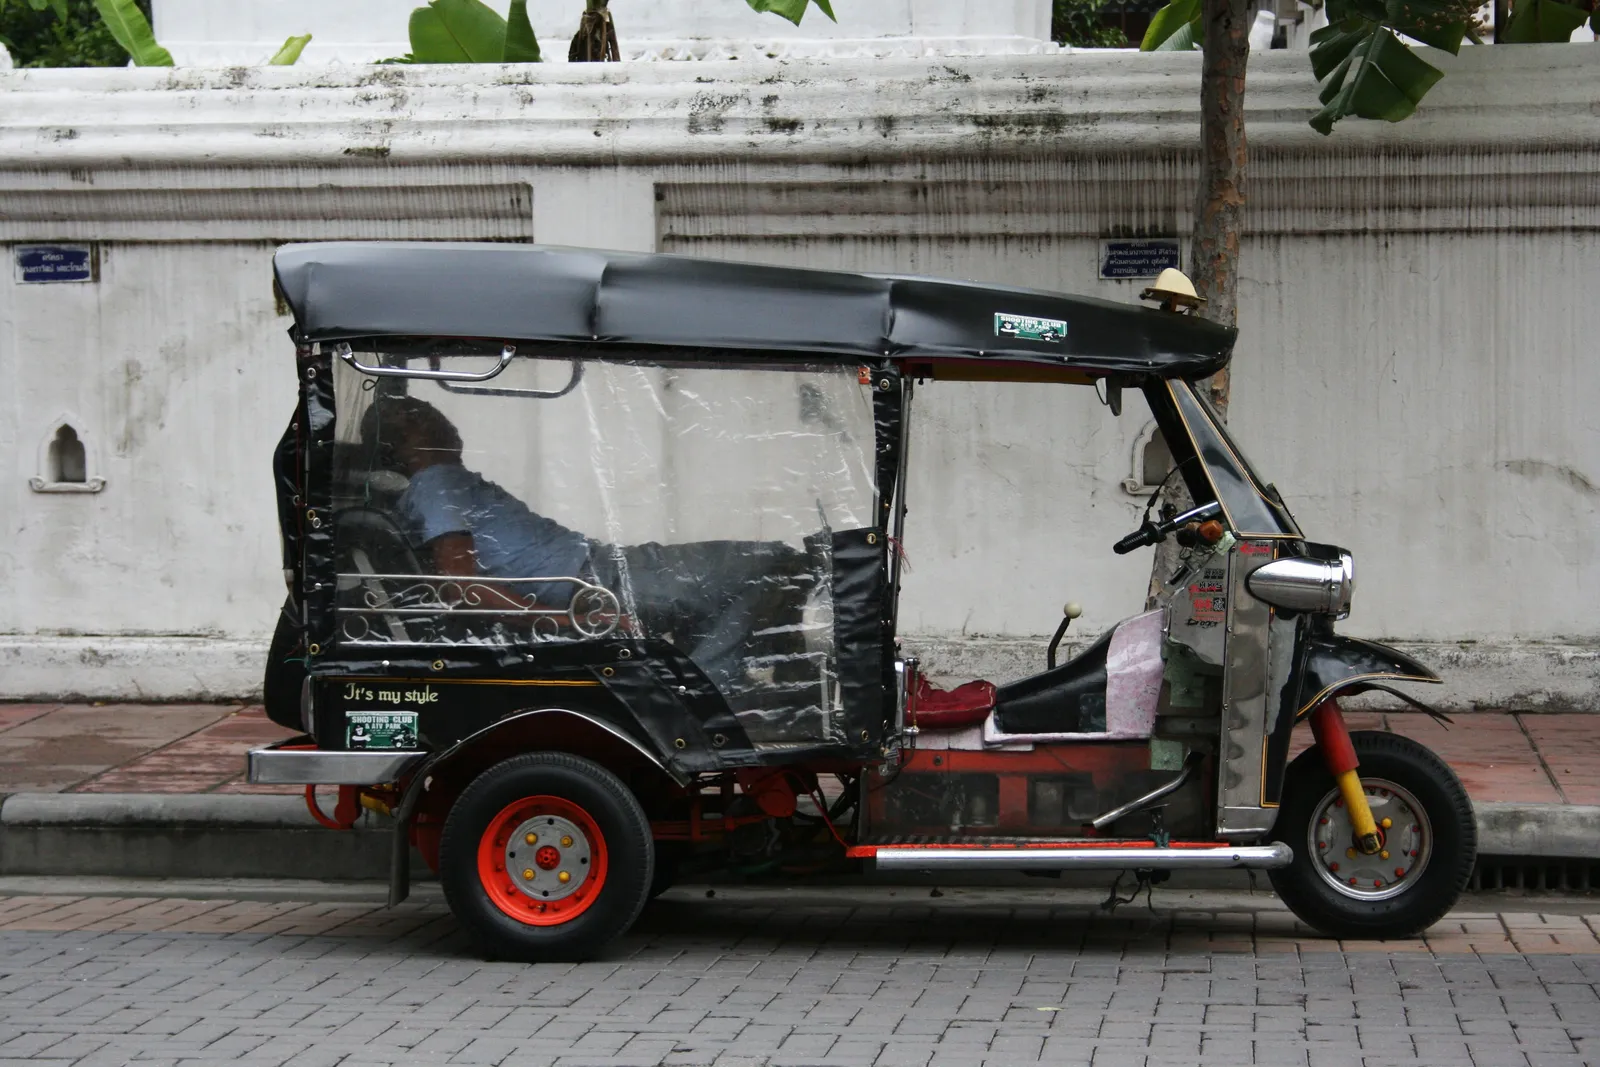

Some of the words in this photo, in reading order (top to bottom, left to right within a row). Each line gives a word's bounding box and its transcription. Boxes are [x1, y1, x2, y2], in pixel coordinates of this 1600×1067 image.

[1000, 315, 1038, 325] SHOOTING
[1042, 320, 1062, 328] CLUB
[344, 682, 374, 701] It's
[378, 690, 401, 704] my
[404, 684, 439, 704] style
